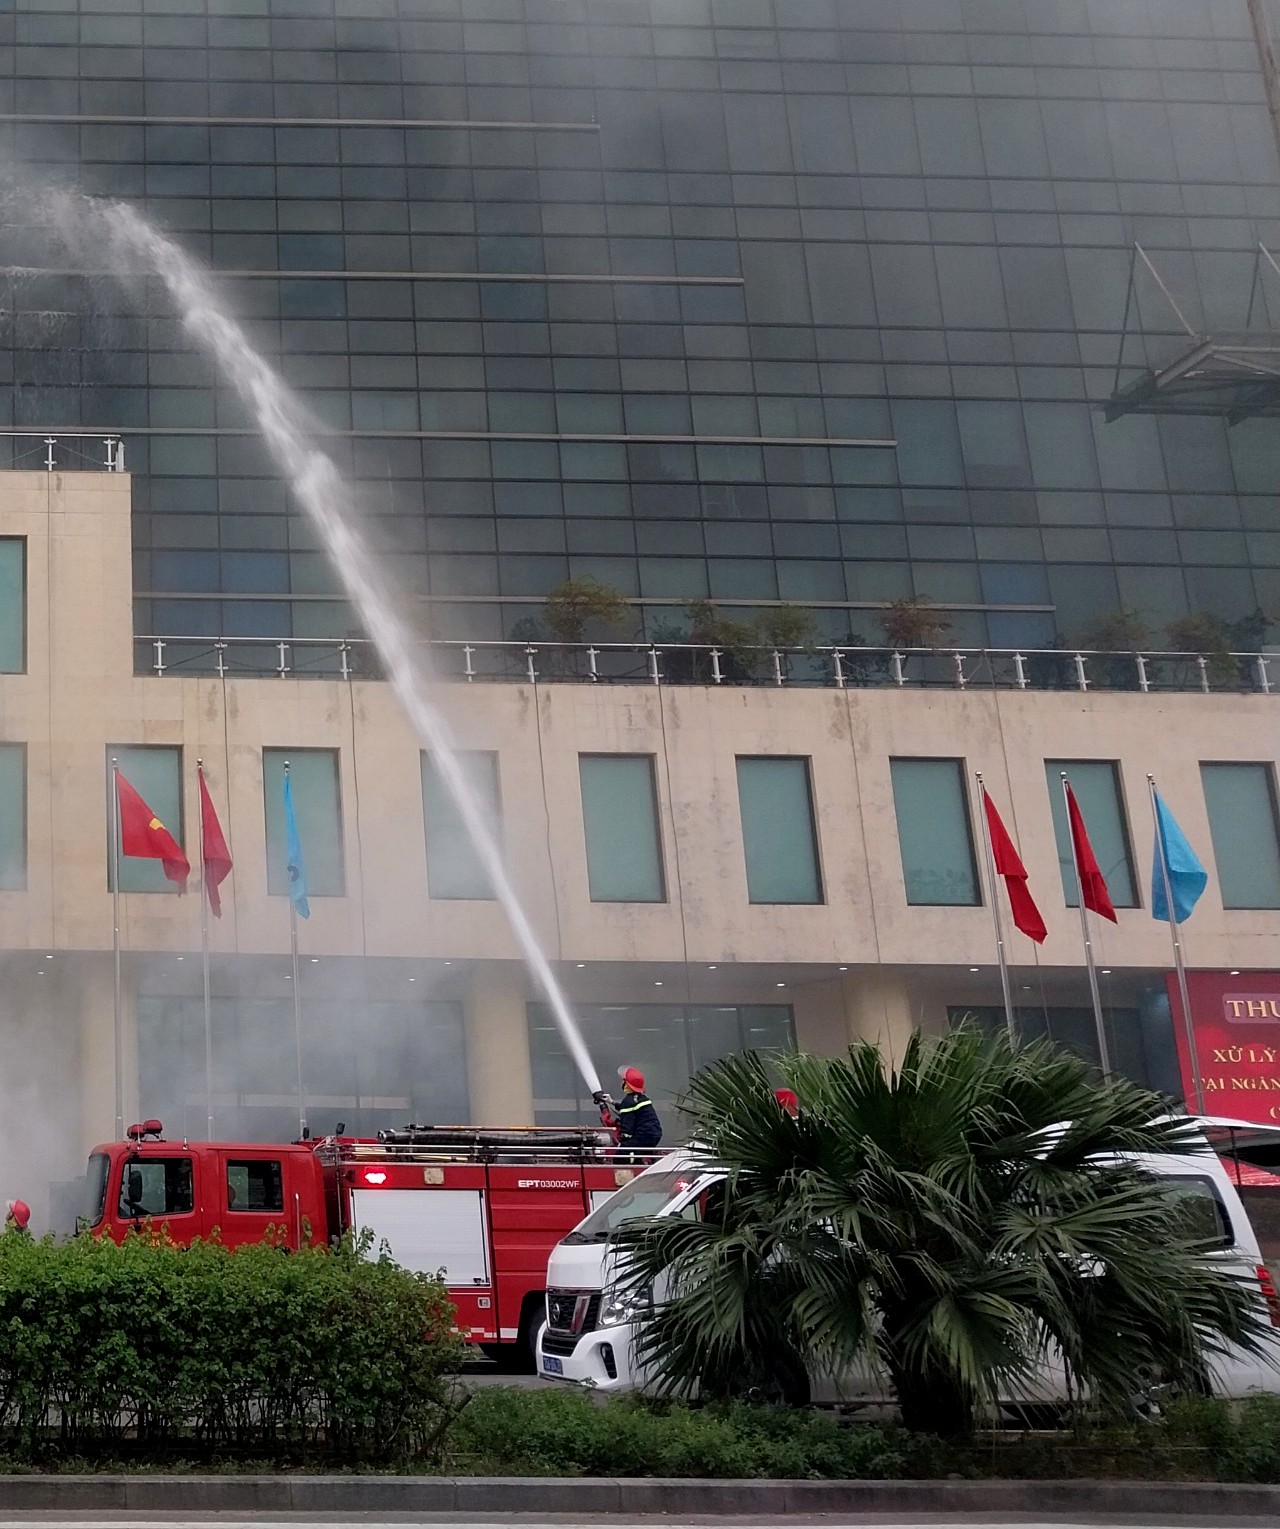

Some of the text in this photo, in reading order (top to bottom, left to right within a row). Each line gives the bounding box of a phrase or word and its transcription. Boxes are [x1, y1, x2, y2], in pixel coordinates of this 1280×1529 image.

[1213, 1045, 1277, 1063] XỬ LÝ
[1192, 1078, 1225, 1092] ẠI
